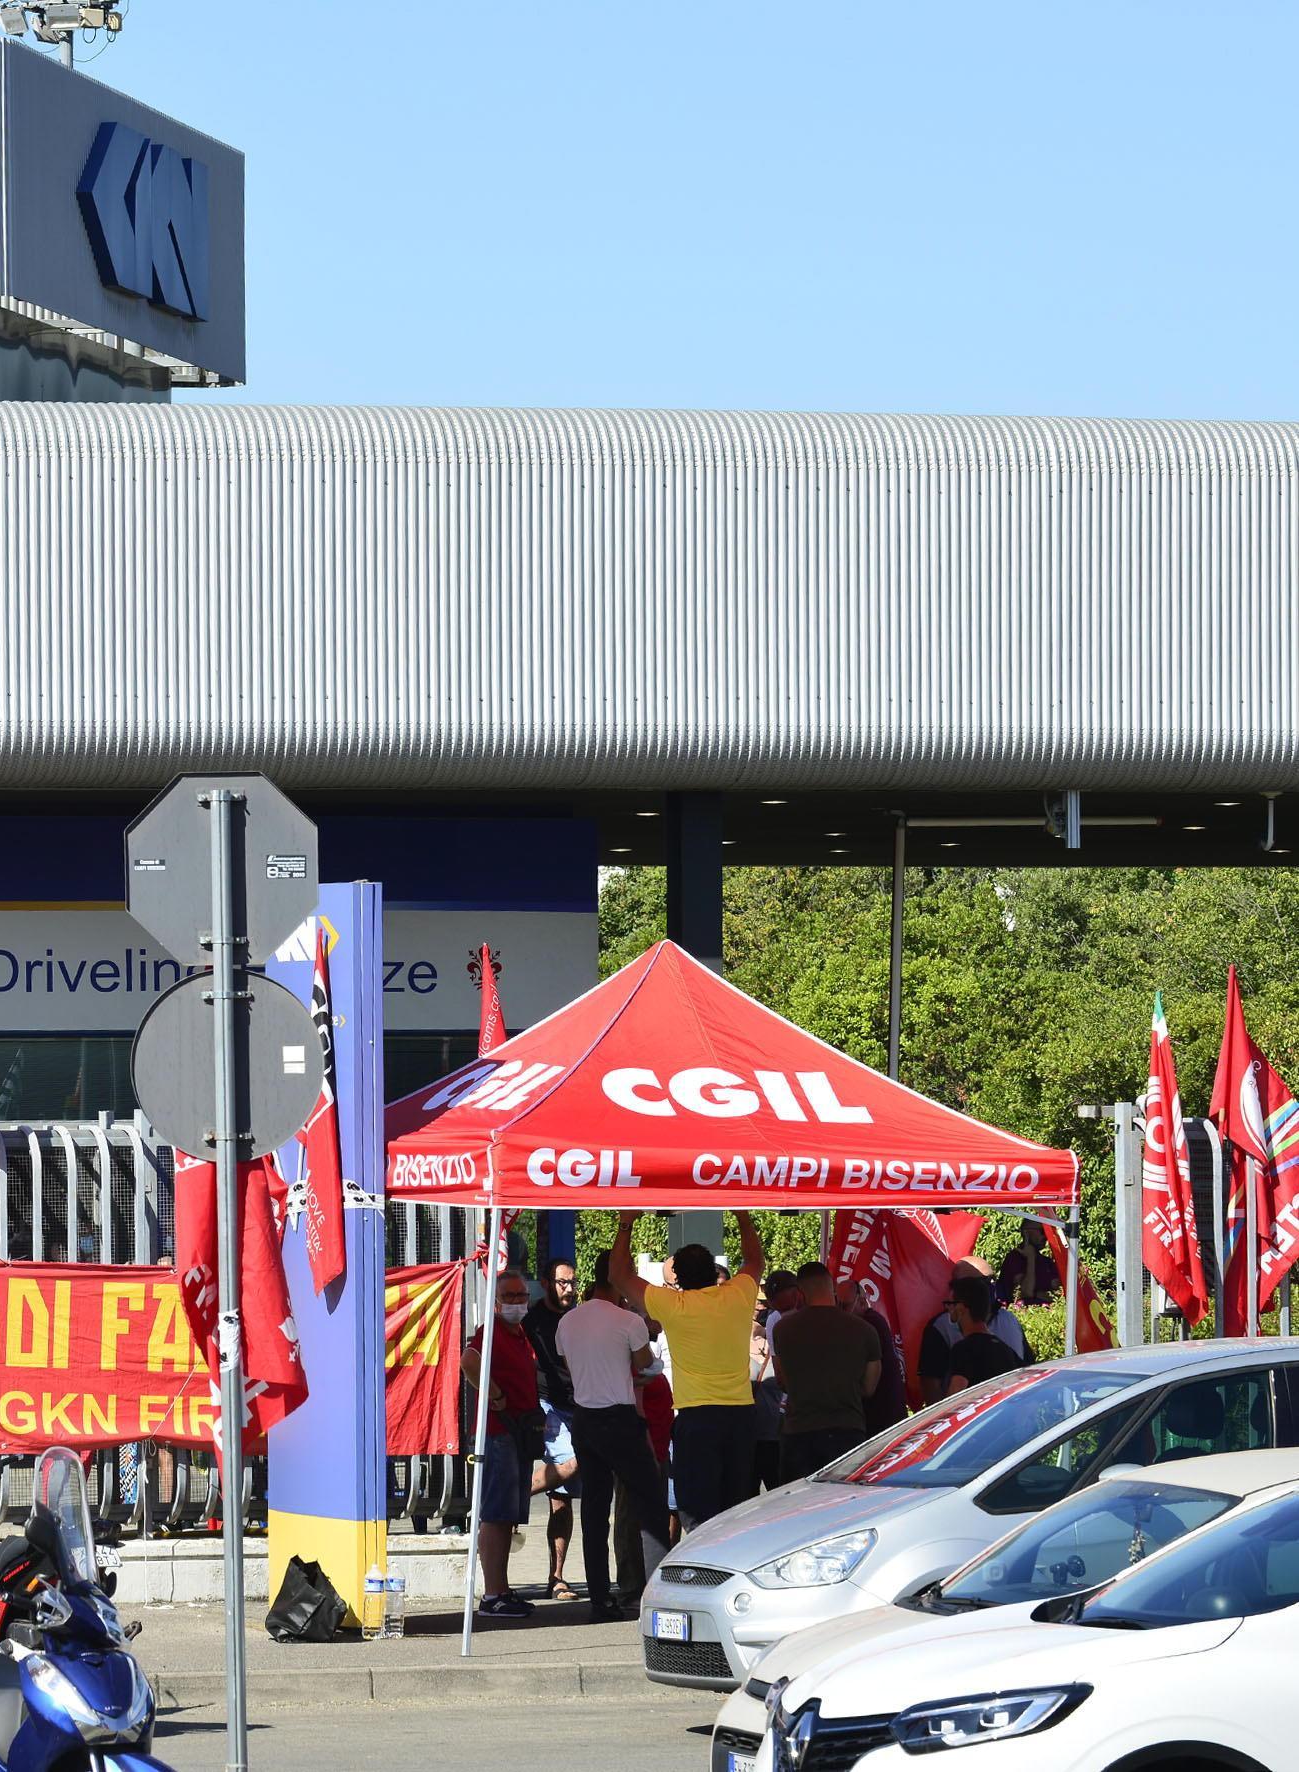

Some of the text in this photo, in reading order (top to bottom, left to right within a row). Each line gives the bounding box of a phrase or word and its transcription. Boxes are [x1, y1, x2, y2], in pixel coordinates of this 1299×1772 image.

[76, 122, 210, 323] GKN
[601, 1067, 875, 1124] CGIL
[392, 1152, 477, 1187] BISENZIO
[526, 1148, 1040, 1193] CGIL CAMPI BISENZIO
[5, 1278, 71, 1369] DI
